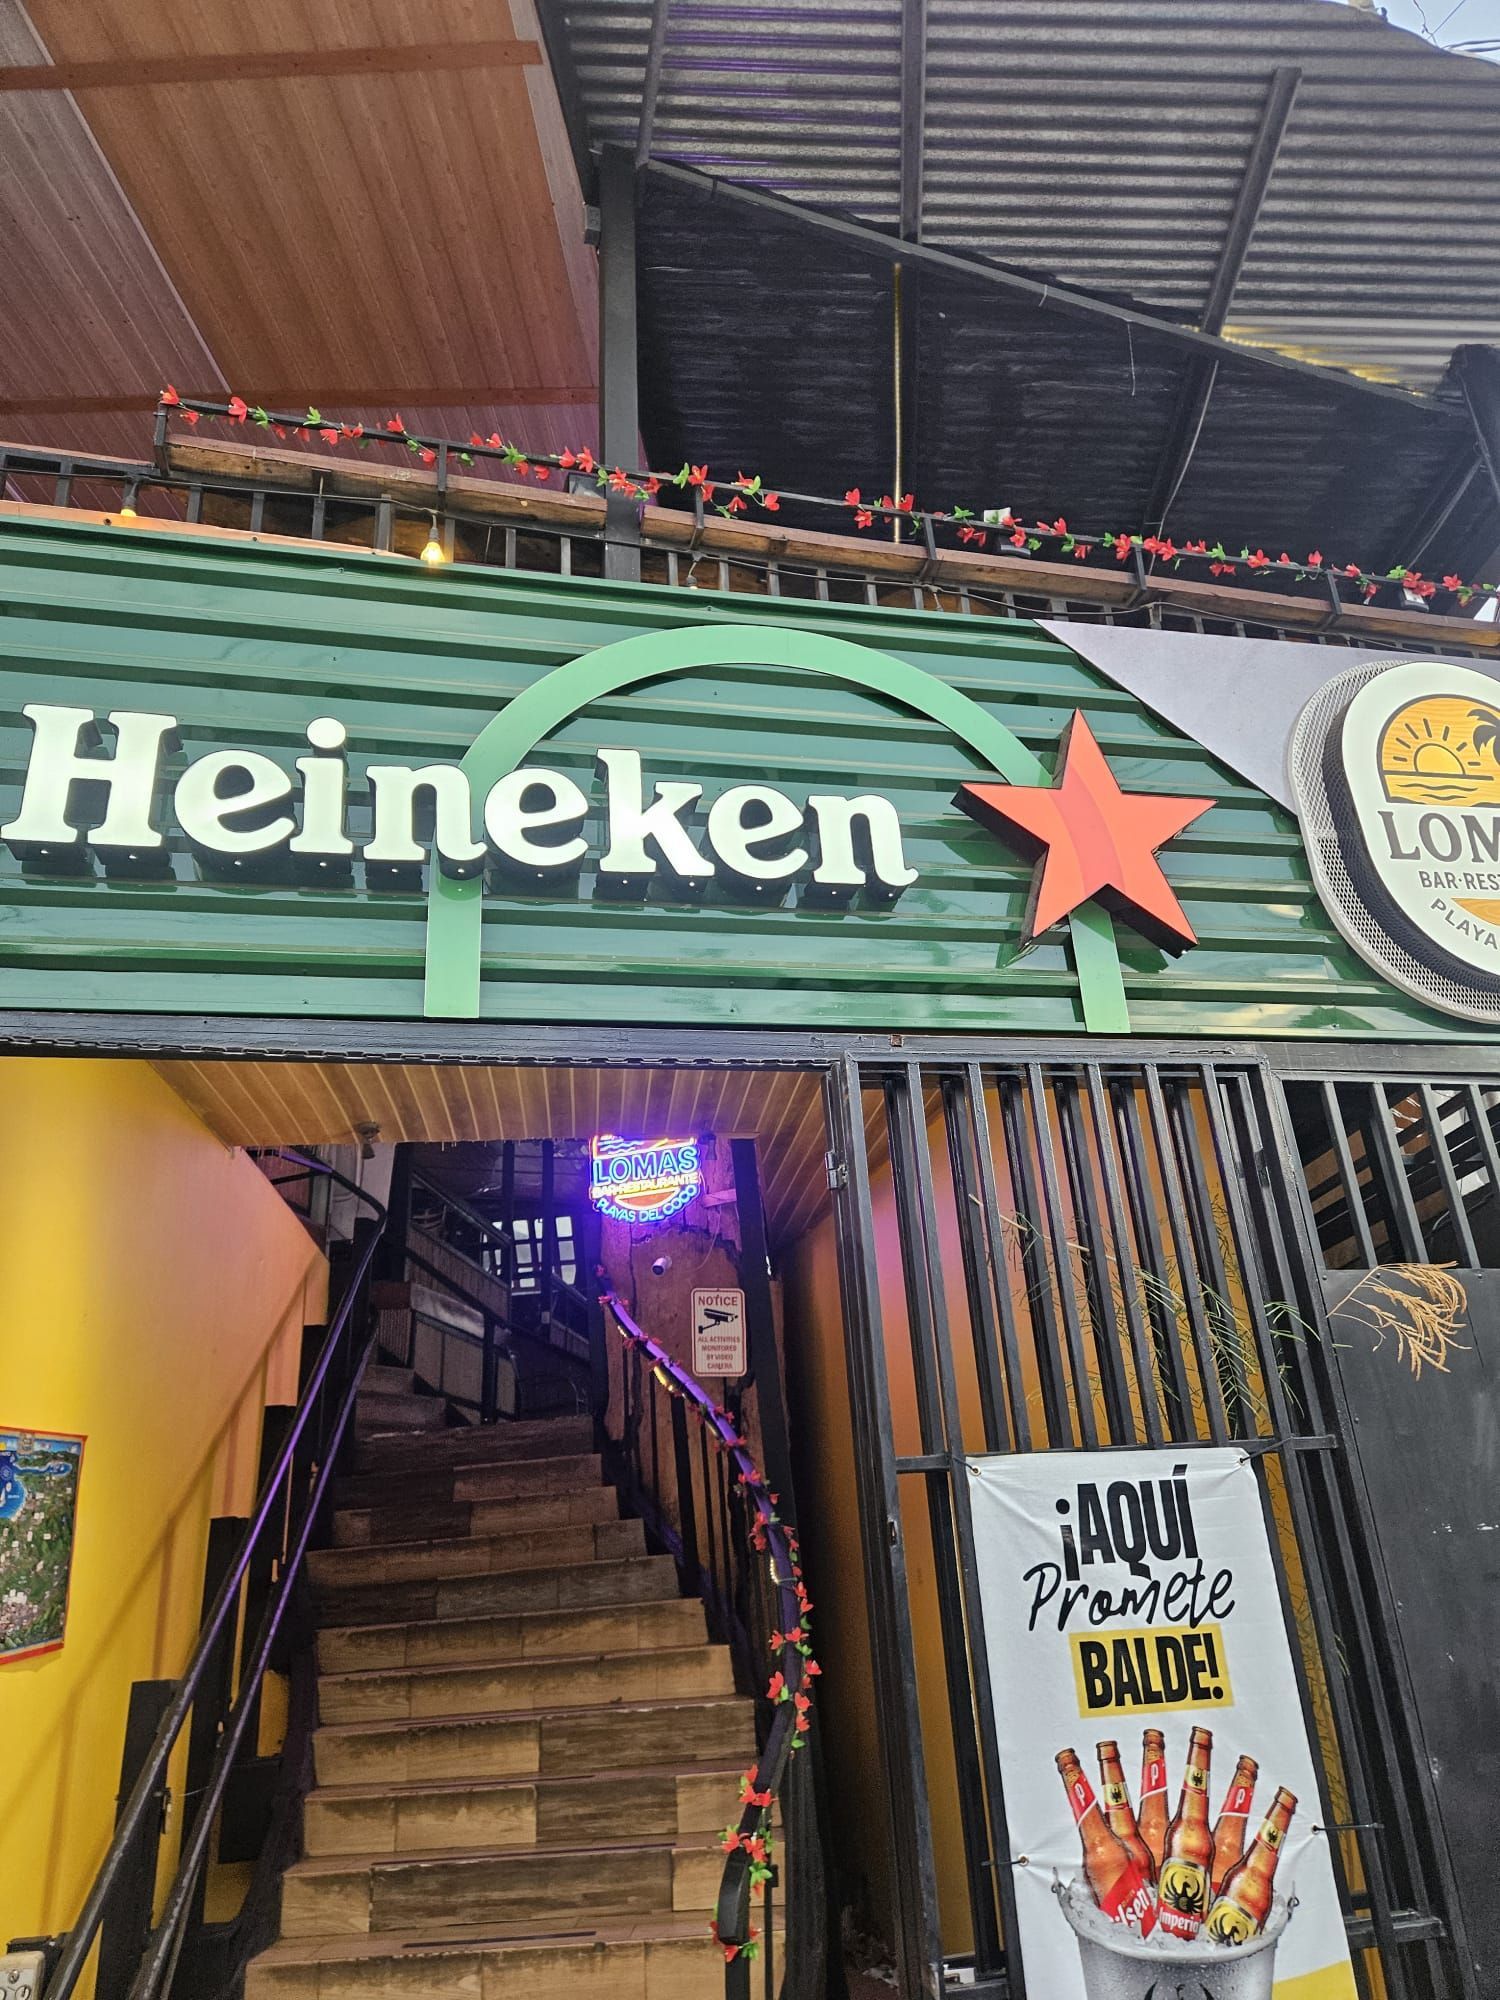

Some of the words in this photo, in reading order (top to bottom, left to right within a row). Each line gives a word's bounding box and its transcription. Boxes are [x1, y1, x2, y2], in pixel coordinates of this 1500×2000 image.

[1, 703, 919, 891] Heineken
[592, 1146, 697, 1187] LOMAS
[597, 1198, 636, 1223] PLAYAS
[639, 1209, 665, 1223] DEL
[662, 1184, 698, 1215] COCO
[698, 1295, 738, 1307] NOTICE
[709, 1336, 741, 1344] ACTIVITIES
[1055, 1464, 1199, 1582] ¡AQUÍ
[1023, 1558, 1235, 1632] Promete
[1079, 1632, 1223, 1709] BALDE!
